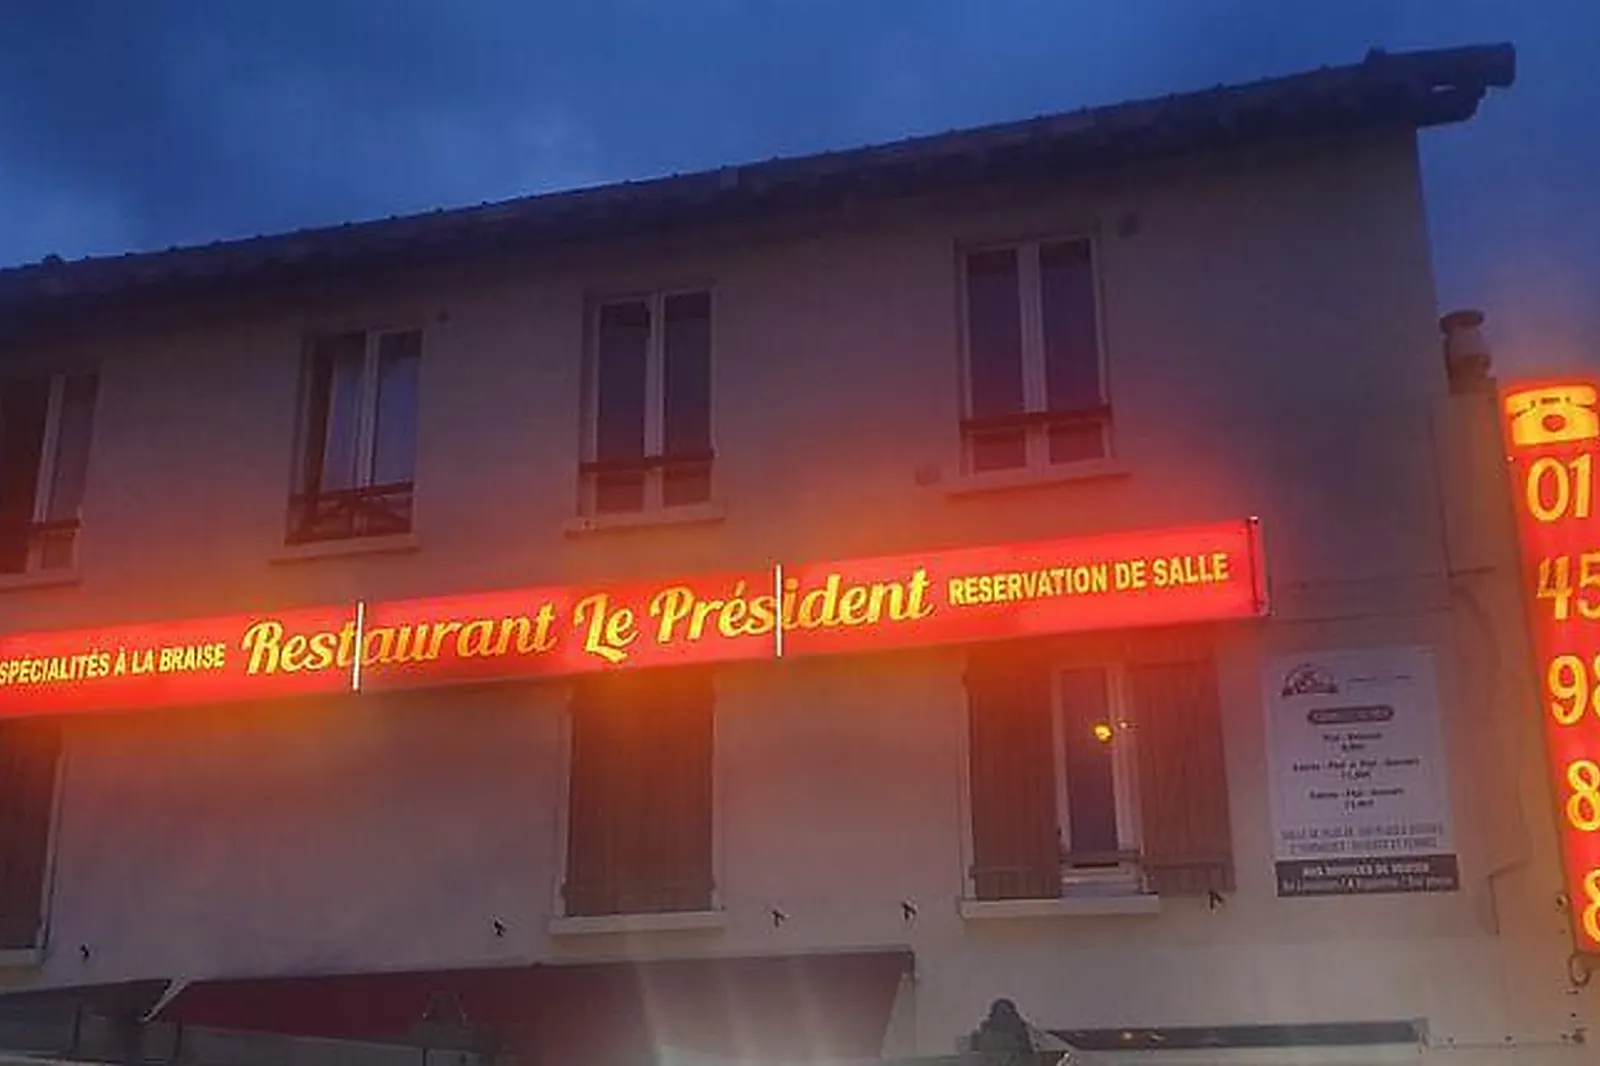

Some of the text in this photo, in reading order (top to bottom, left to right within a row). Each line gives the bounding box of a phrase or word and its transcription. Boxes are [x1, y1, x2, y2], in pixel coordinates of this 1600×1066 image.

[1527, 453, 1592, 521] 01
[948, 552, 1229, 605] RESERVATION DE SALLE
[1535, 552, 1600, 621] 45
[241, 567, 936, 675] Restaurant Le Président
[131, 653, 155, 673] LA
[159, 641, 226, 671] BRAISE
